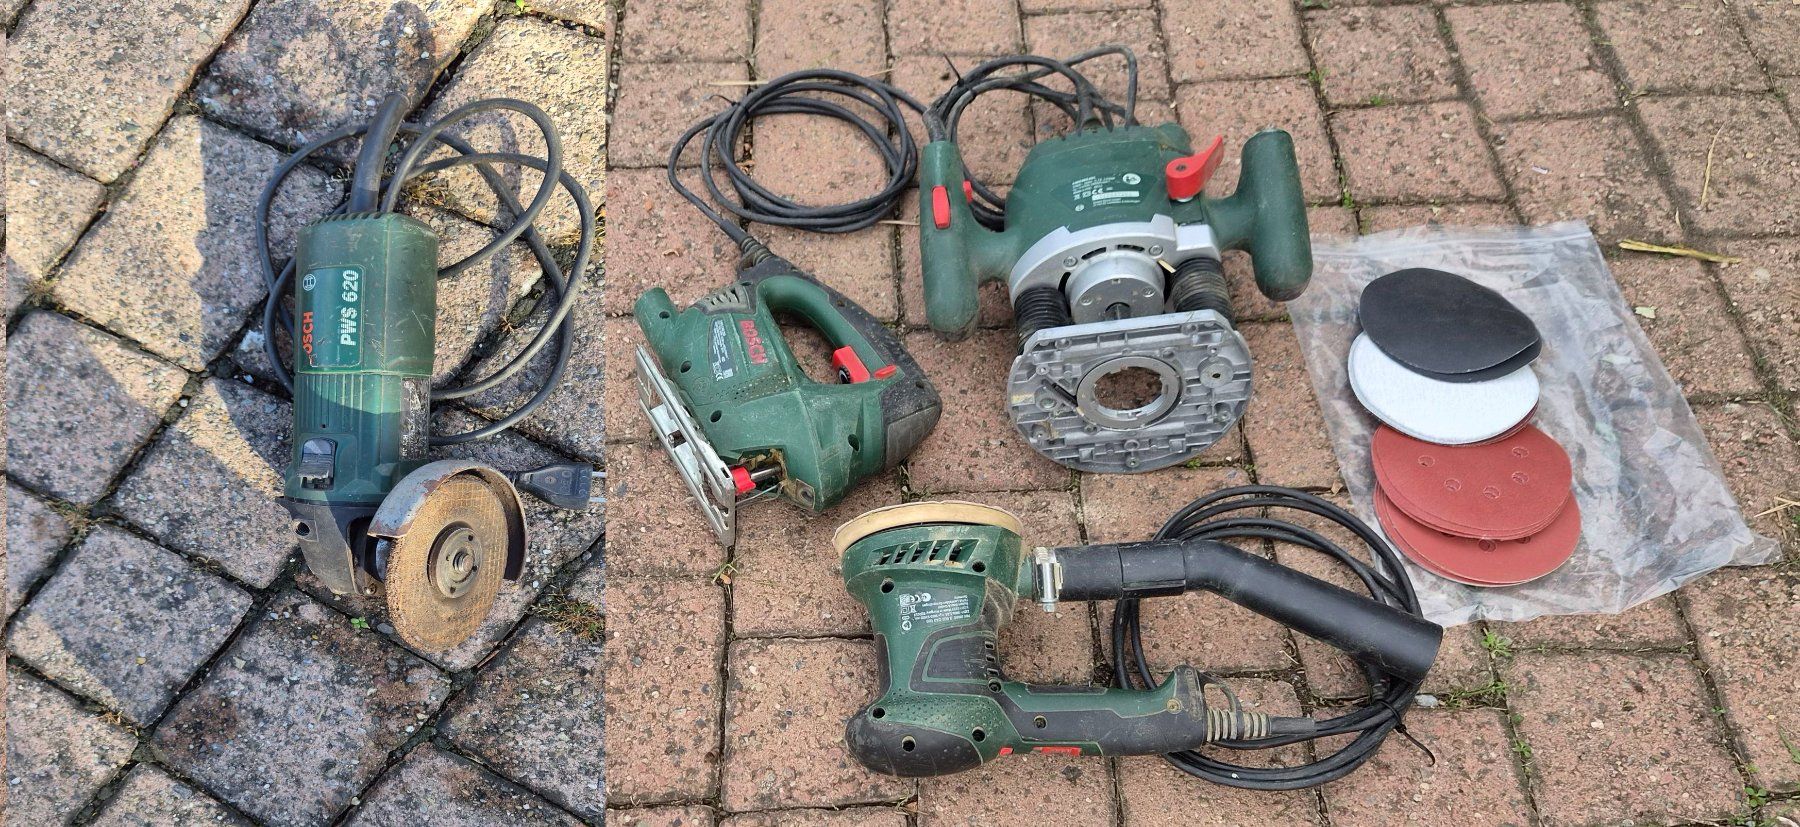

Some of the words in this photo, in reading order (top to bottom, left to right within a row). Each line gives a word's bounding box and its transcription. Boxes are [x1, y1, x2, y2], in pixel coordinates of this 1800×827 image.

[341, 269, 359, 303] 620
[303, 311, 314, 358] OSCH
[340, 306, 358, 346] PWS
[739, 319, 769, 366] BOSCH
